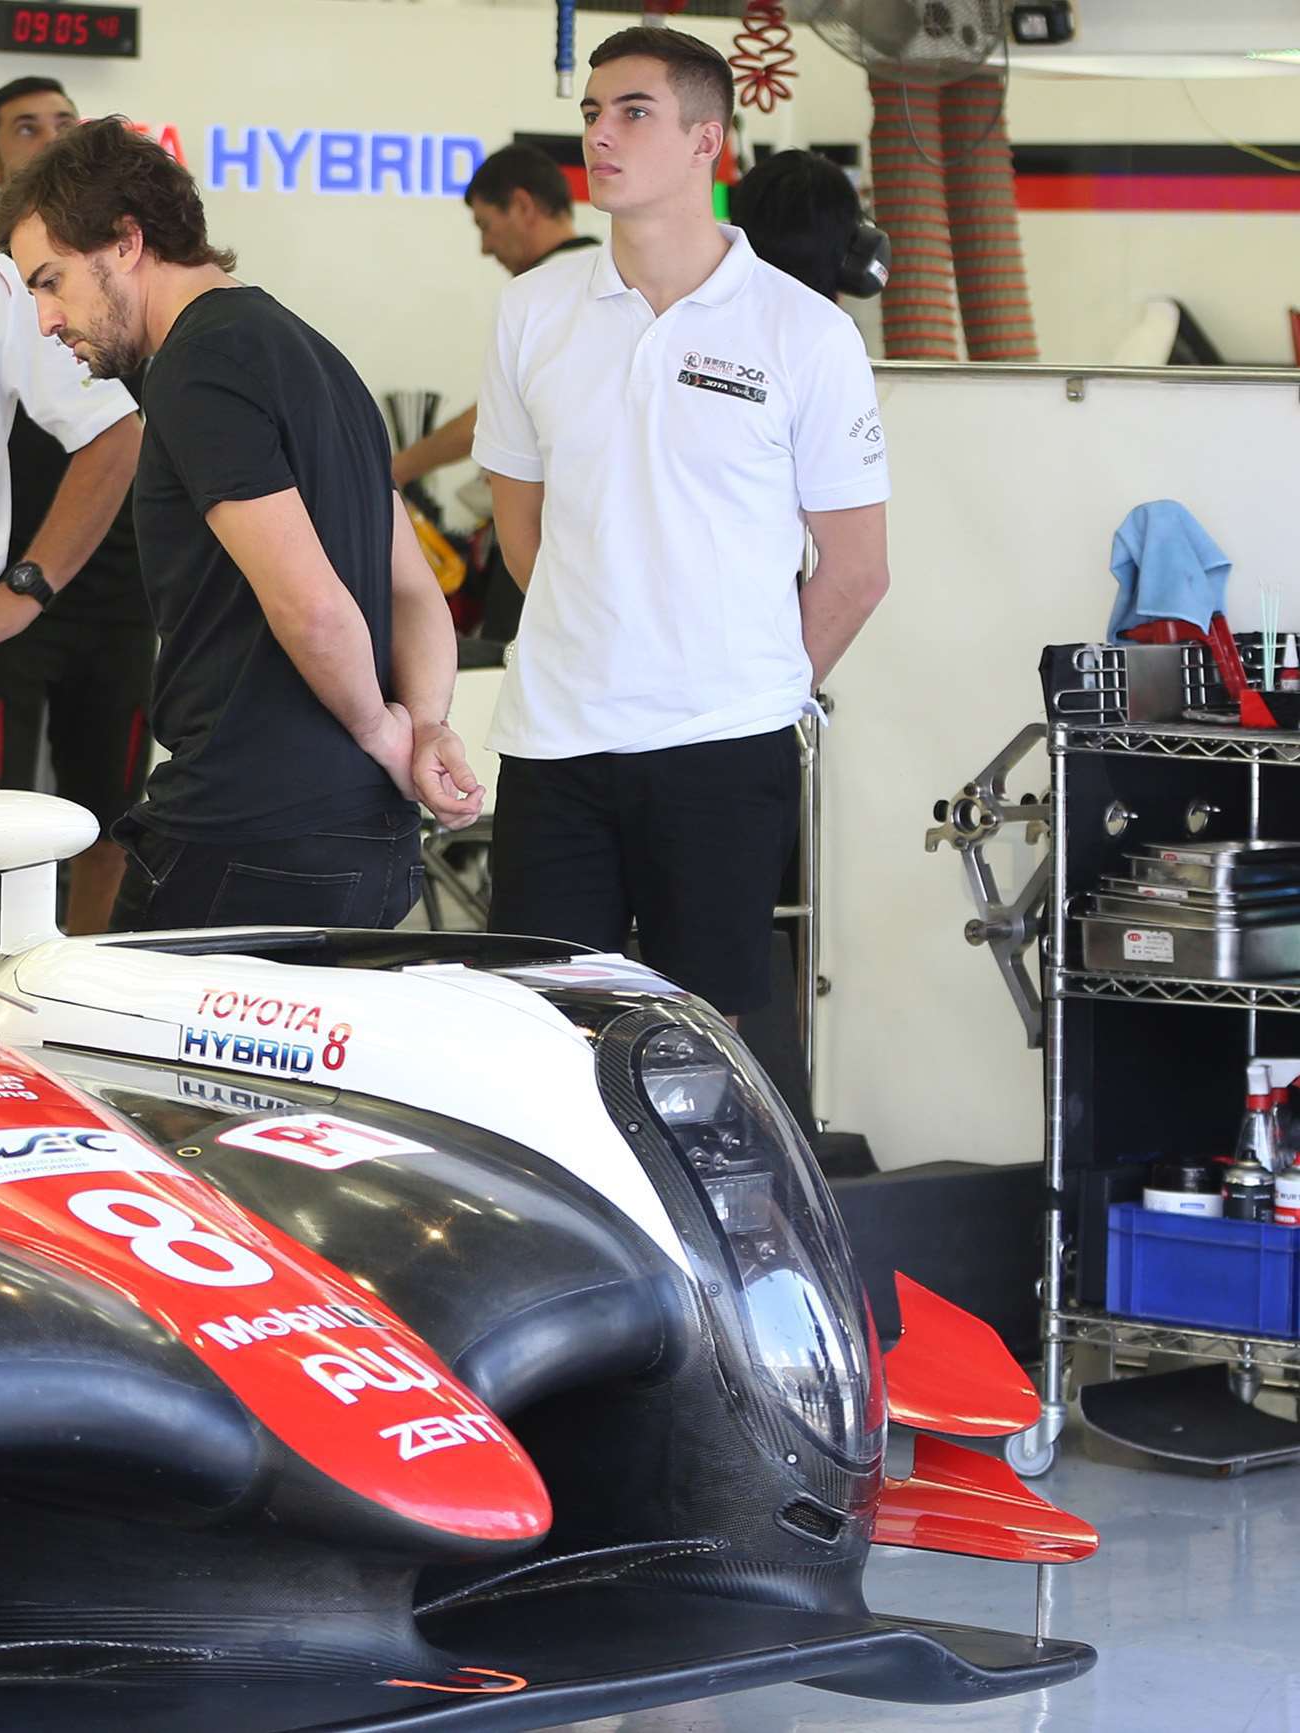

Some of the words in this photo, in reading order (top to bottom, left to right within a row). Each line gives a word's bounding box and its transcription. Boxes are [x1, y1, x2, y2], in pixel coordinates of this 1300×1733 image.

[211, 127, 486, 195] HYBRID
[849, 417, 864, 438] DEEP
[197, 988, 323, 1034] TOYOTA
[184, 1027, 314, 1073] HYBRID
[322, 1022, 353, 1071] 8
[253, 1120, 401, 1157] P1
[68, 1188, 275, 1287] 8
[198, 1304, 347, 1351] Mobil
[379, 1413, 503, 1461] ZENT
